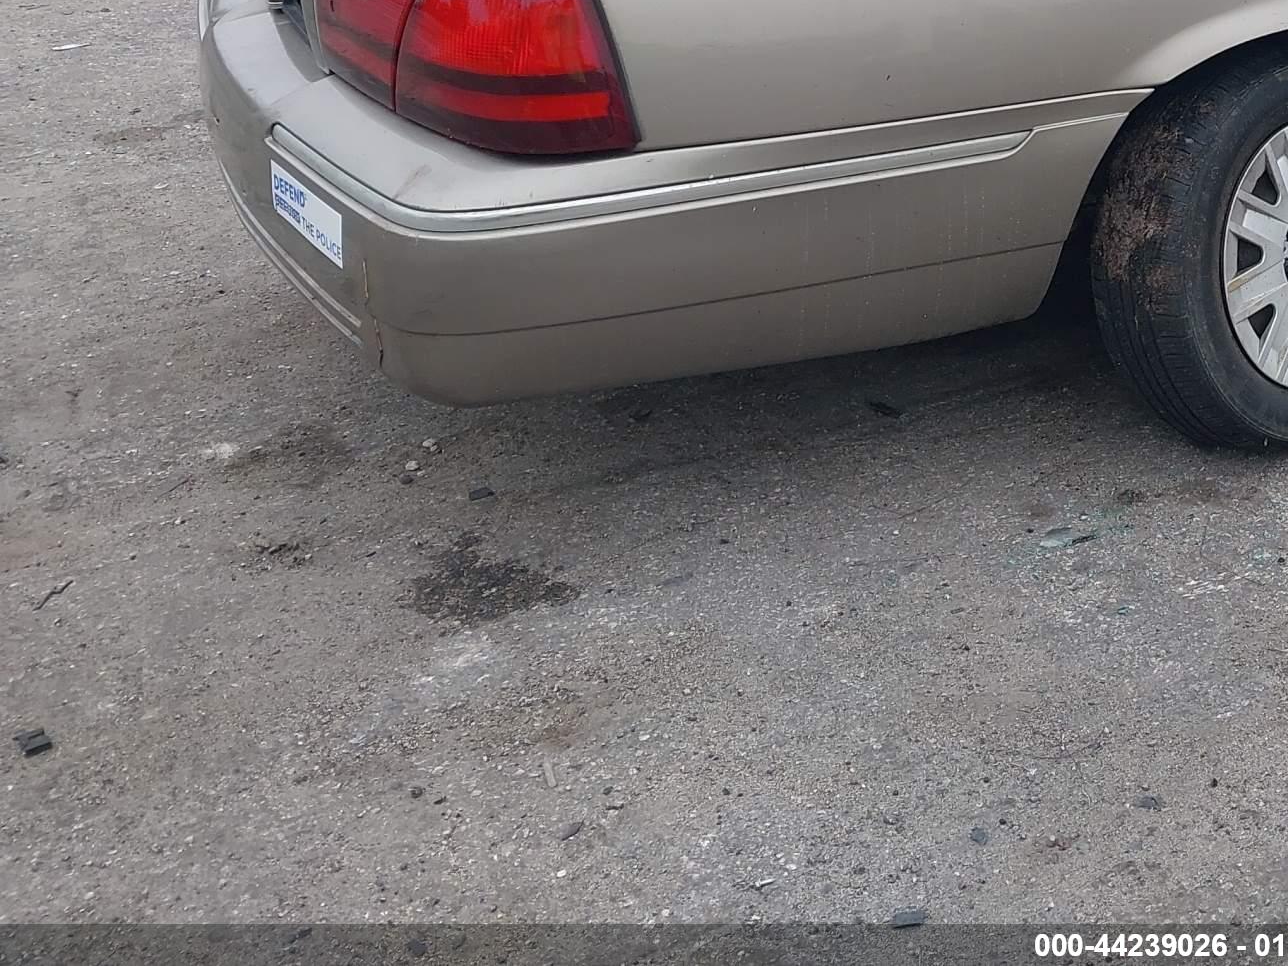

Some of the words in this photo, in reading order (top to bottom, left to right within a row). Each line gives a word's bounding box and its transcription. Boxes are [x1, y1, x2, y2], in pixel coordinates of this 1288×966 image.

[273, 174, 306, 208] DEFEND
[301, 216, 315, 237] THE
[316, 229, 342, 260] POLICE
